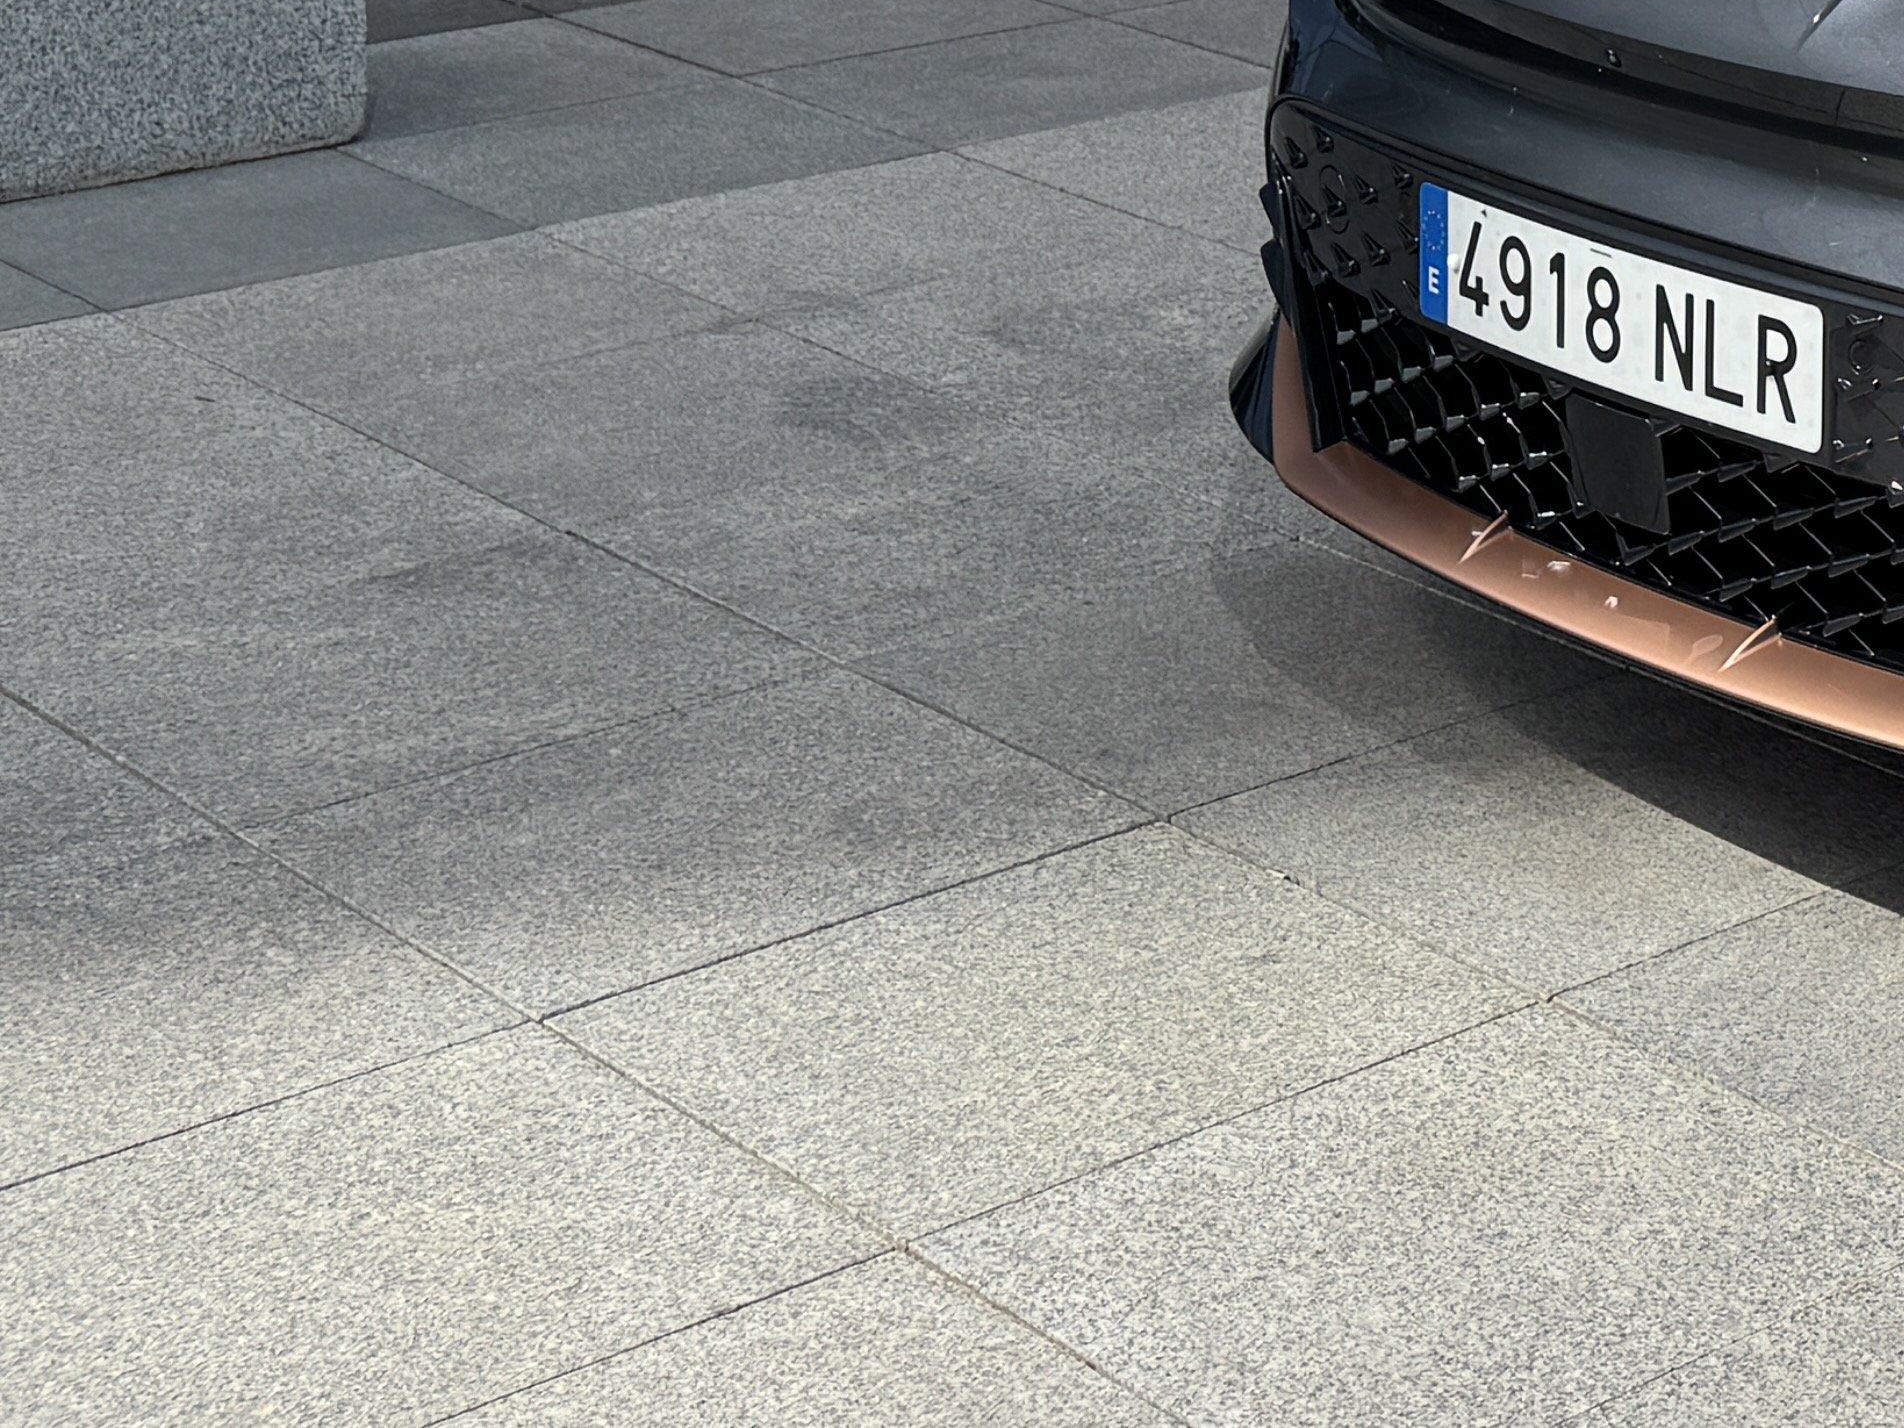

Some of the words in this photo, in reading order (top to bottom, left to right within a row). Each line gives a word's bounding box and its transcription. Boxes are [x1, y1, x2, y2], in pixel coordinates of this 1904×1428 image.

[1428, 265, 1440, 294] E
[1458, 221, 1621, 364] 4918
[1655, 283, 1798, 425] NLR
